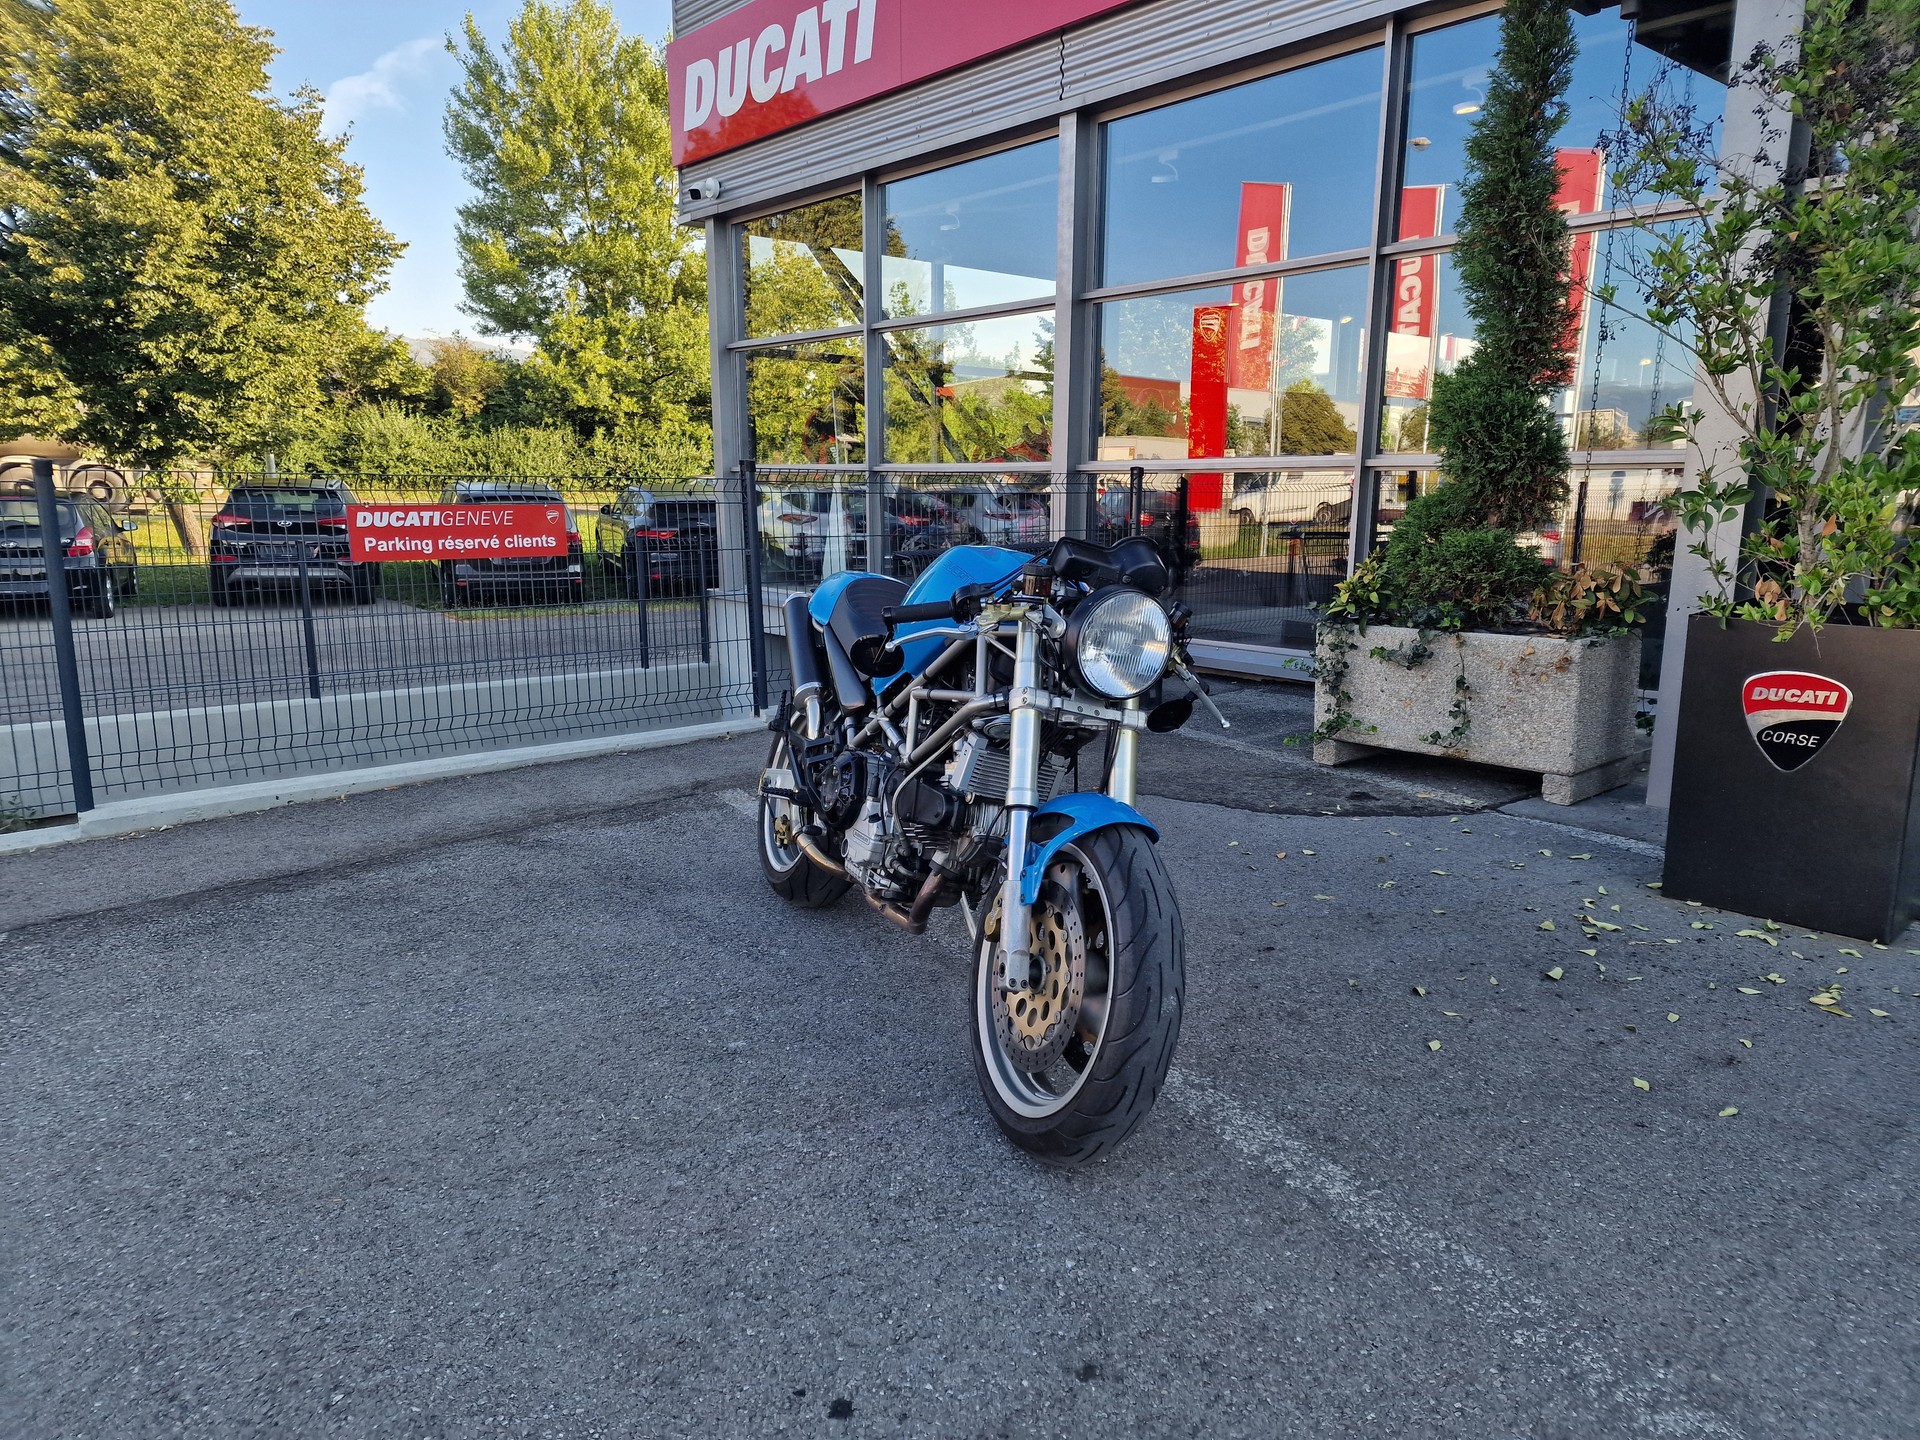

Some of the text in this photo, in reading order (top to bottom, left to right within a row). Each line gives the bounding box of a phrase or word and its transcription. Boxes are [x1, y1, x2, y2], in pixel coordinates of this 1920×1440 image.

[684, 0, 877, 132] DUCATI
[364, 534, 557, 554] Parking réservé clients
[1751, 687, 1839, 705] DUCATI
[1761, 730, 1820, 748] CORSE
